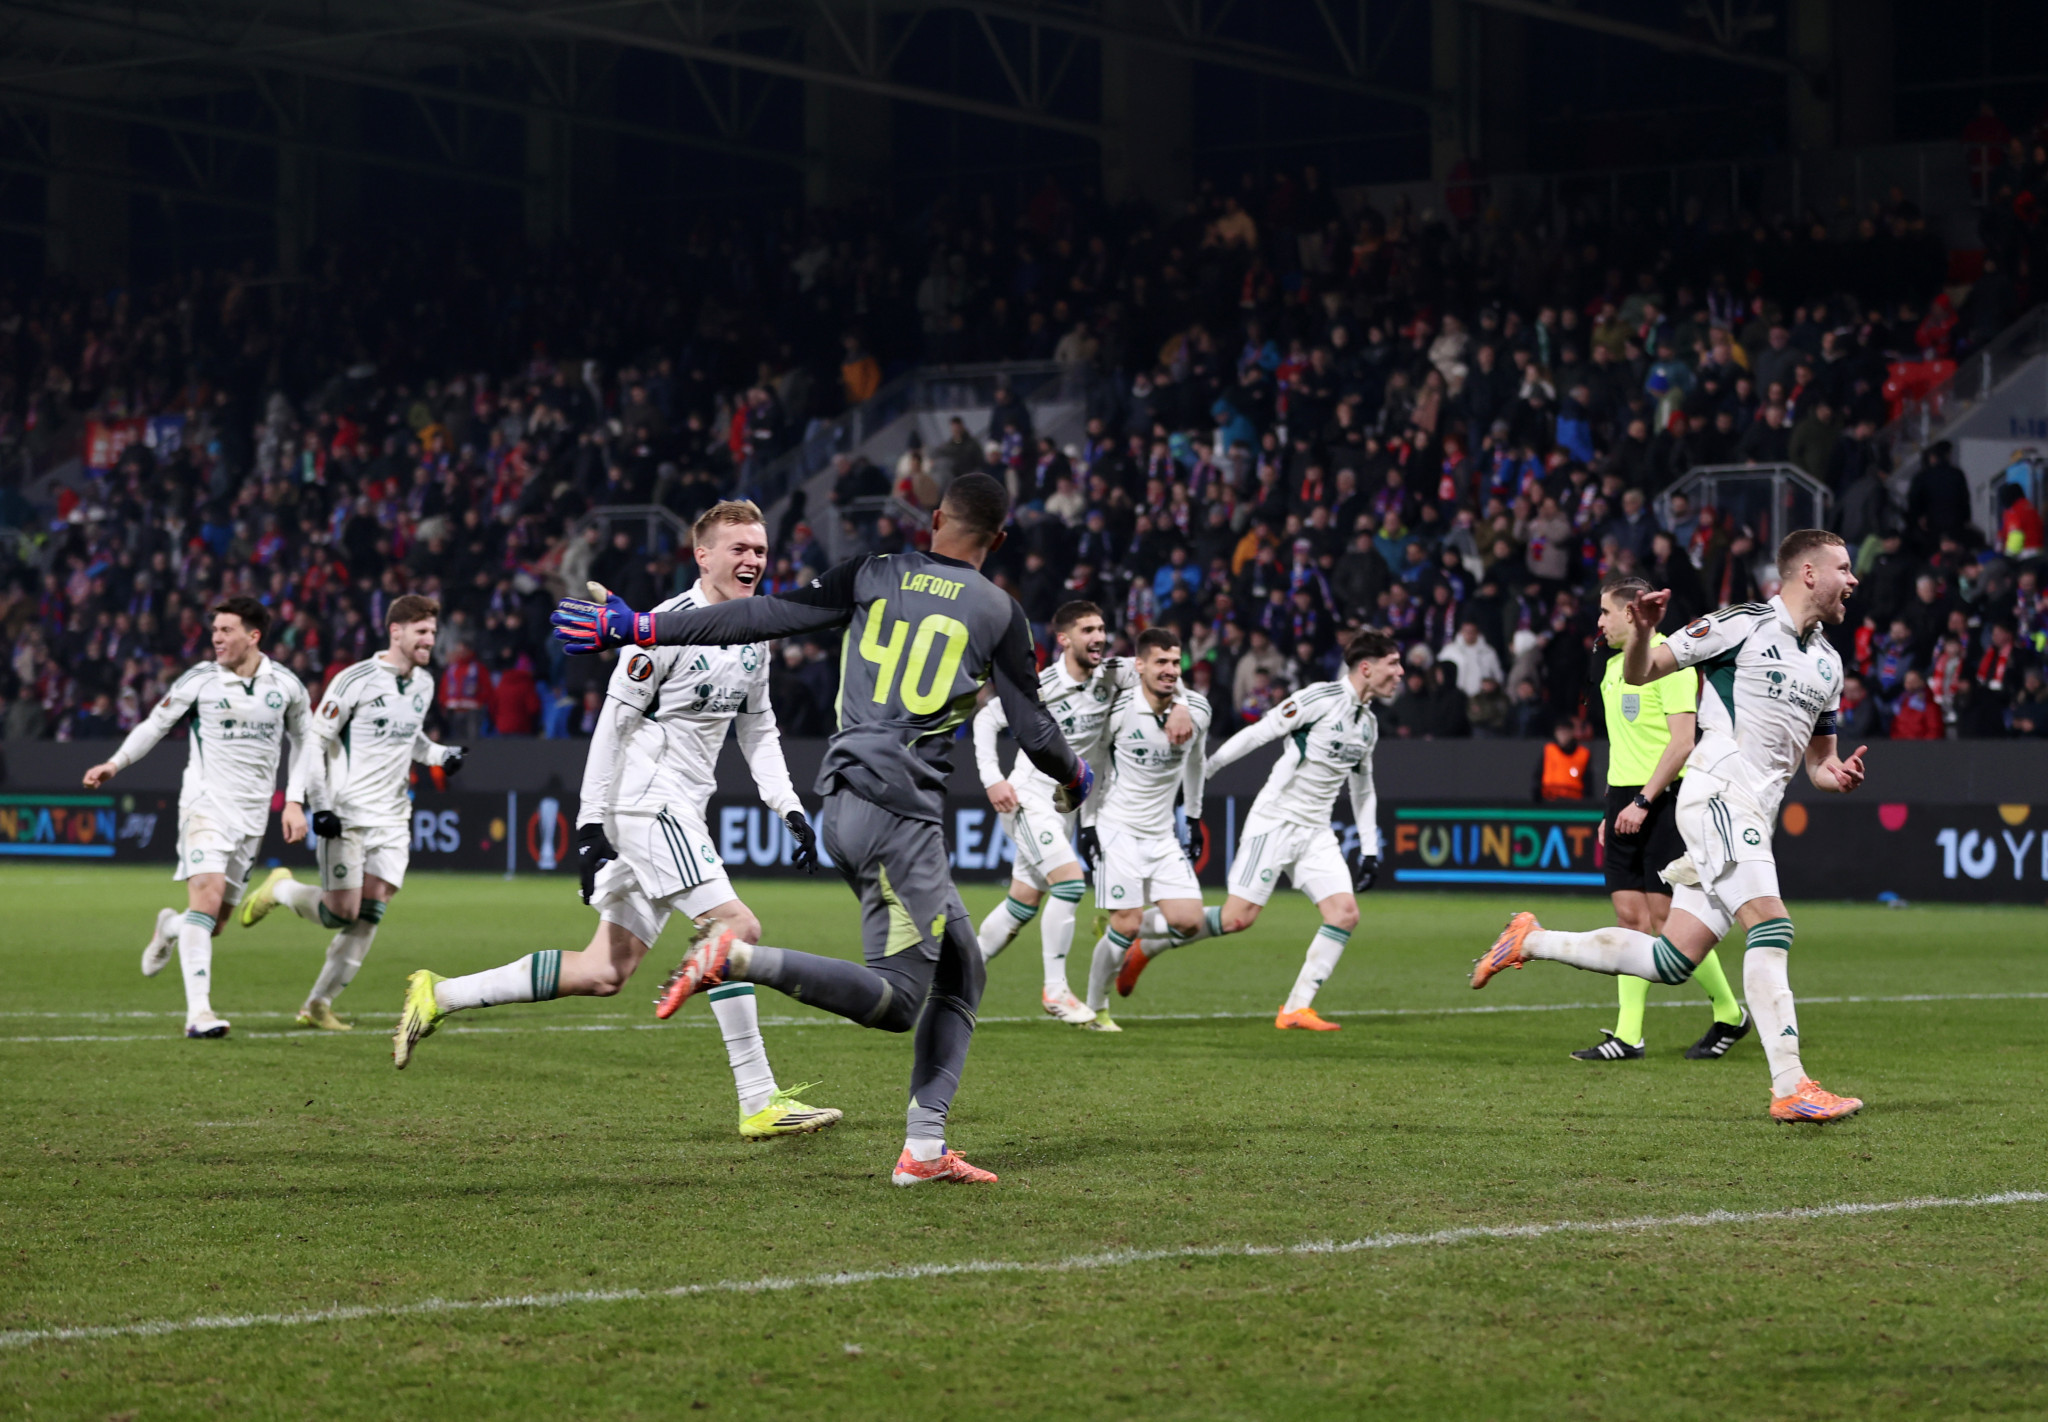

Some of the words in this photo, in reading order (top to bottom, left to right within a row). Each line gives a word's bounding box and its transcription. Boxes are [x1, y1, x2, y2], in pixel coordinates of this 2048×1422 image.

[901, 571, 966, 600] LAFONT
[859, 598, 969, 715] 40
[1790, 679, 1798, 690] A
[1800, 682, 1825, 703] Little
[1936, 828, 1997, 879] 10
